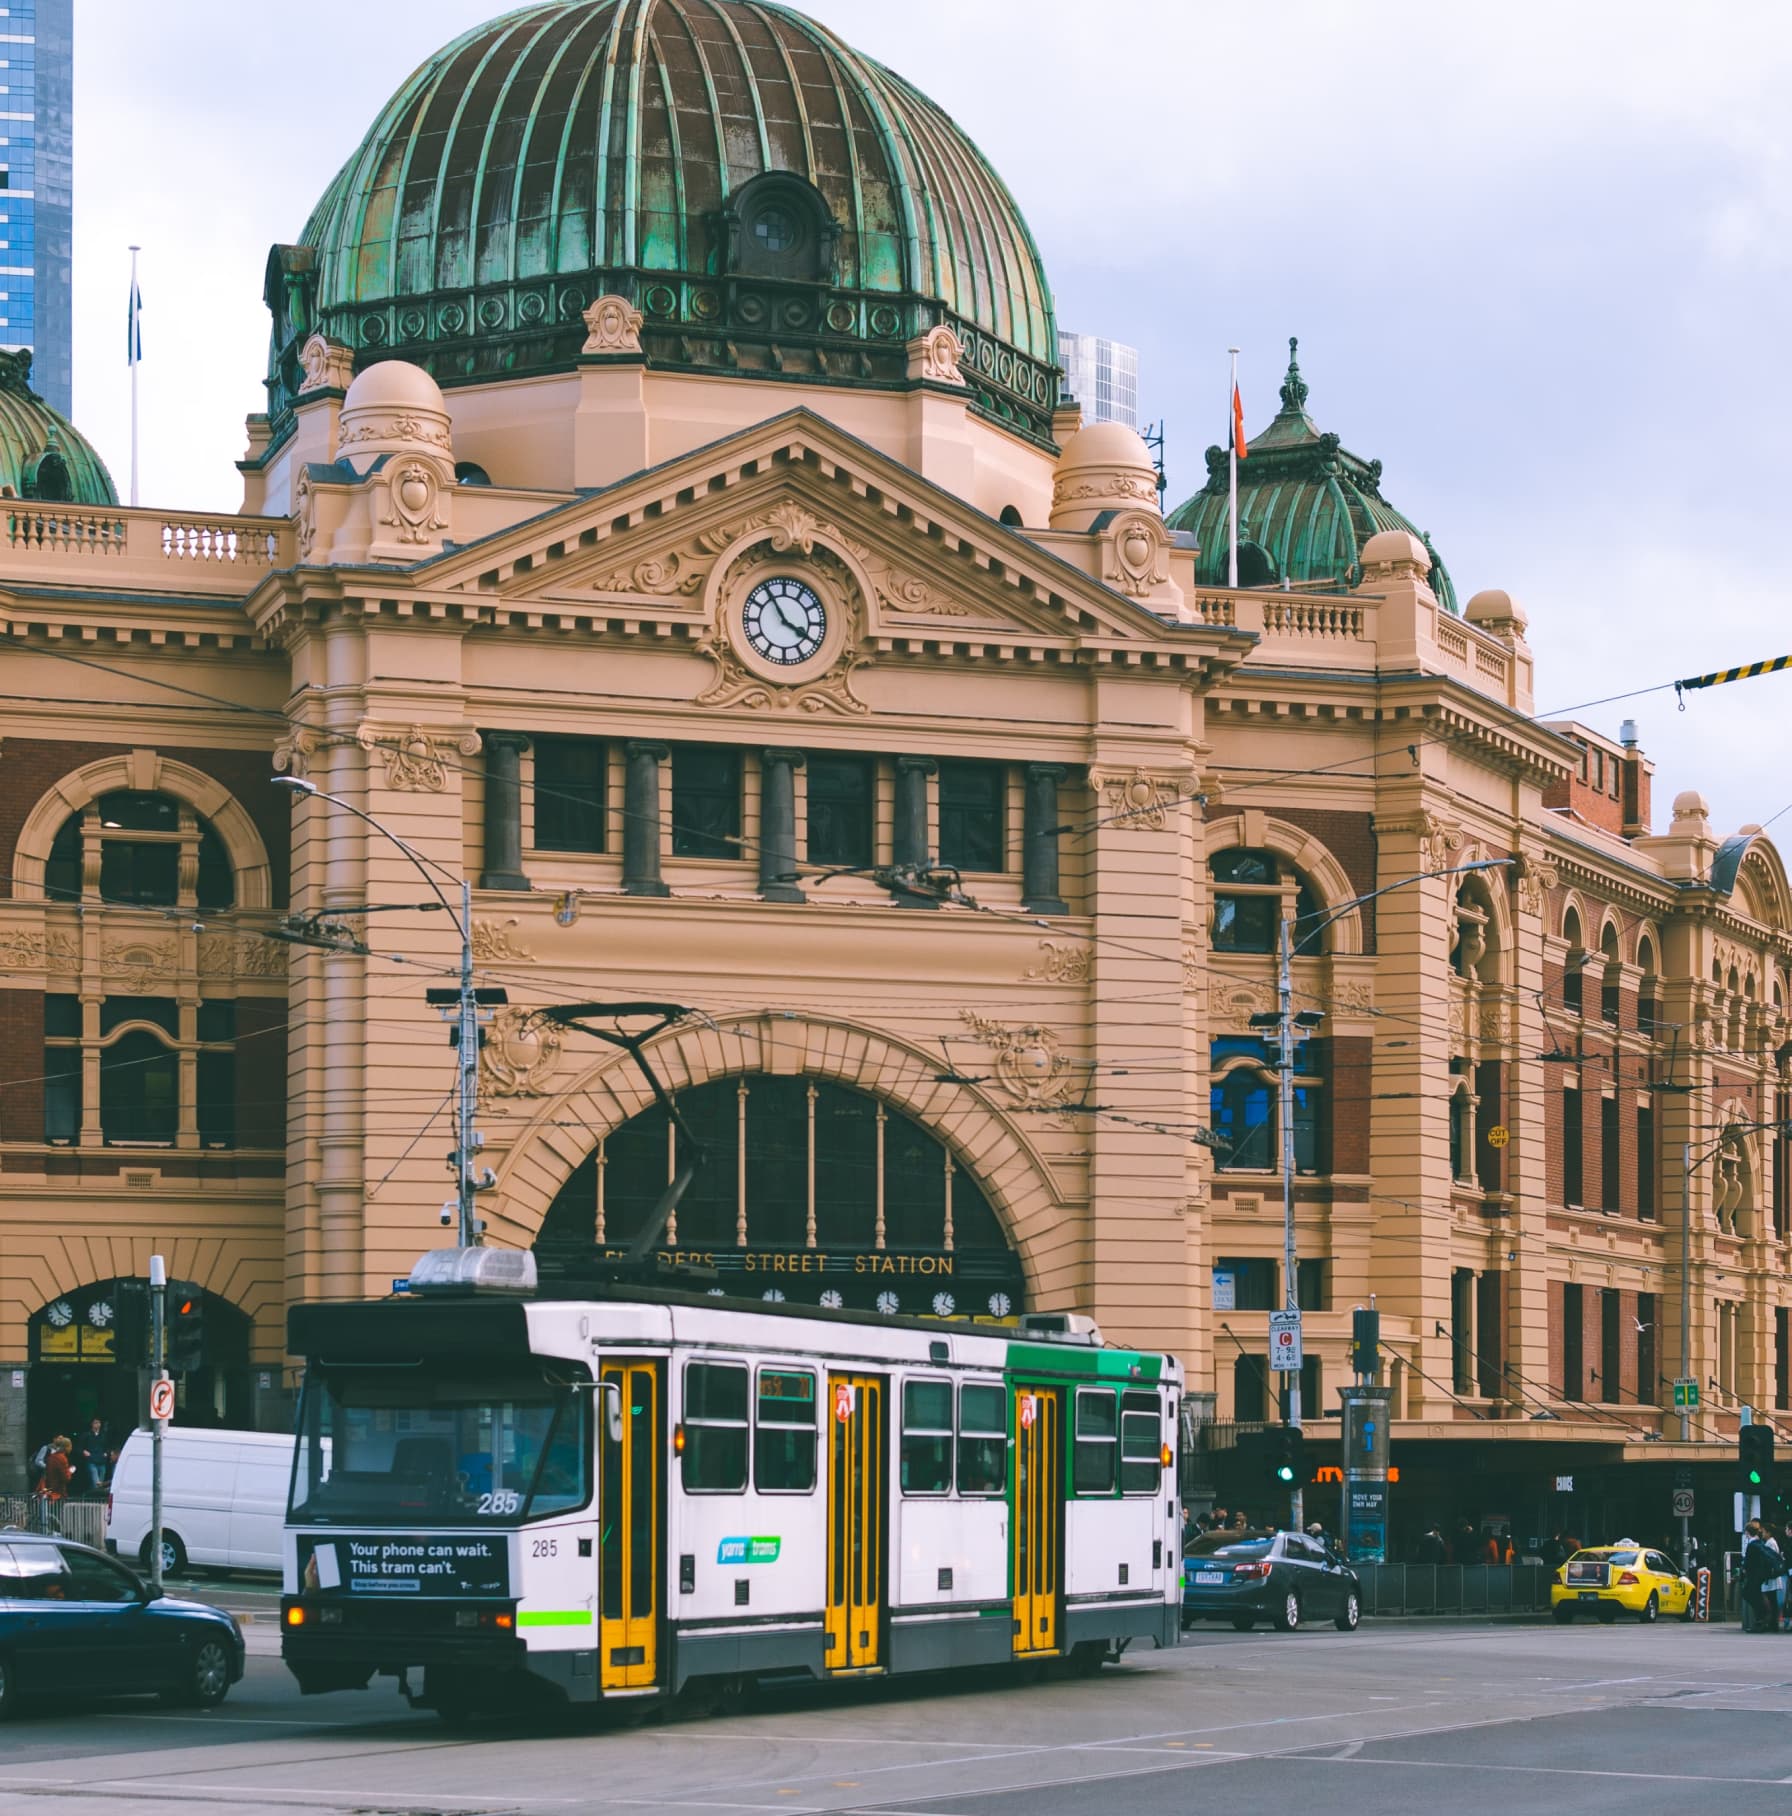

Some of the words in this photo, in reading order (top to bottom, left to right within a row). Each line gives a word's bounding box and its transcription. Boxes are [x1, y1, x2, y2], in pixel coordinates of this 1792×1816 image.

[1490, 1128, 1505, 1137] CUT
[605, 1251, 715, 1268] FDERS
[745, 1254, 828, 1272] STREET
[855, 1255, 953, 1274] STATION
[477, 1492, 519, 1515] 285
[1675, 1497, 1691, 1508] 40
[350, 1542, 379, 1556] Your
[382, 1543, 424, 1559] phone
[428, 1546, 453, 1556] can
[456, 1543, 492, 1556] wait.
[532, 1540, 558, 1558] 285
[350, 1560, 378, 1573] This
[381, 1561, 415, 1574] tram
[418, 1561, 456, 1574] can't.
